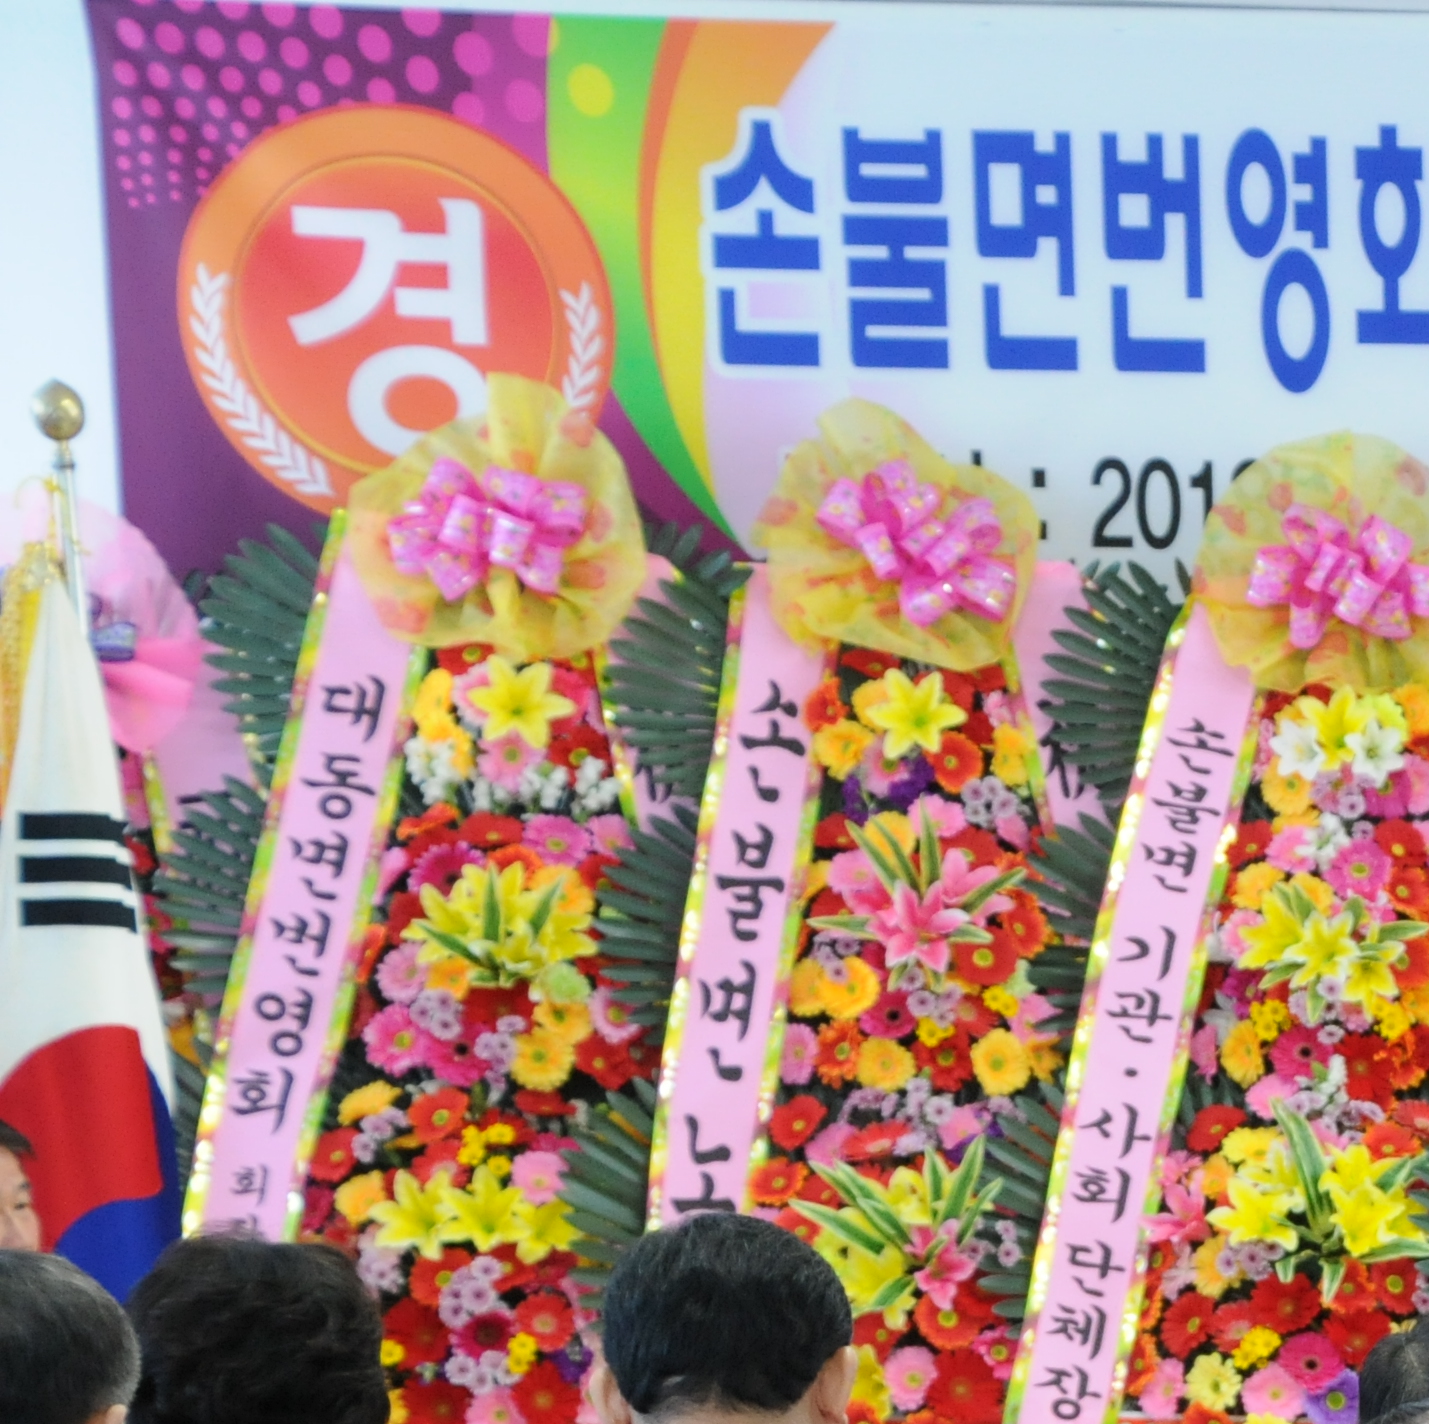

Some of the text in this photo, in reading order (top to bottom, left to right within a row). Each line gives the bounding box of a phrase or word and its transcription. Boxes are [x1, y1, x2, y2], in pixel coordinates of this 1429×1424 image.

[287, 196, 492, 460] 경
[1091, 456, 1256, 550] 201
[231, 674, 388, 1136] 대동면번영회
[699, 680, 806, 1081] 손불면
[1140, 717, 1234, 894] 손불면
